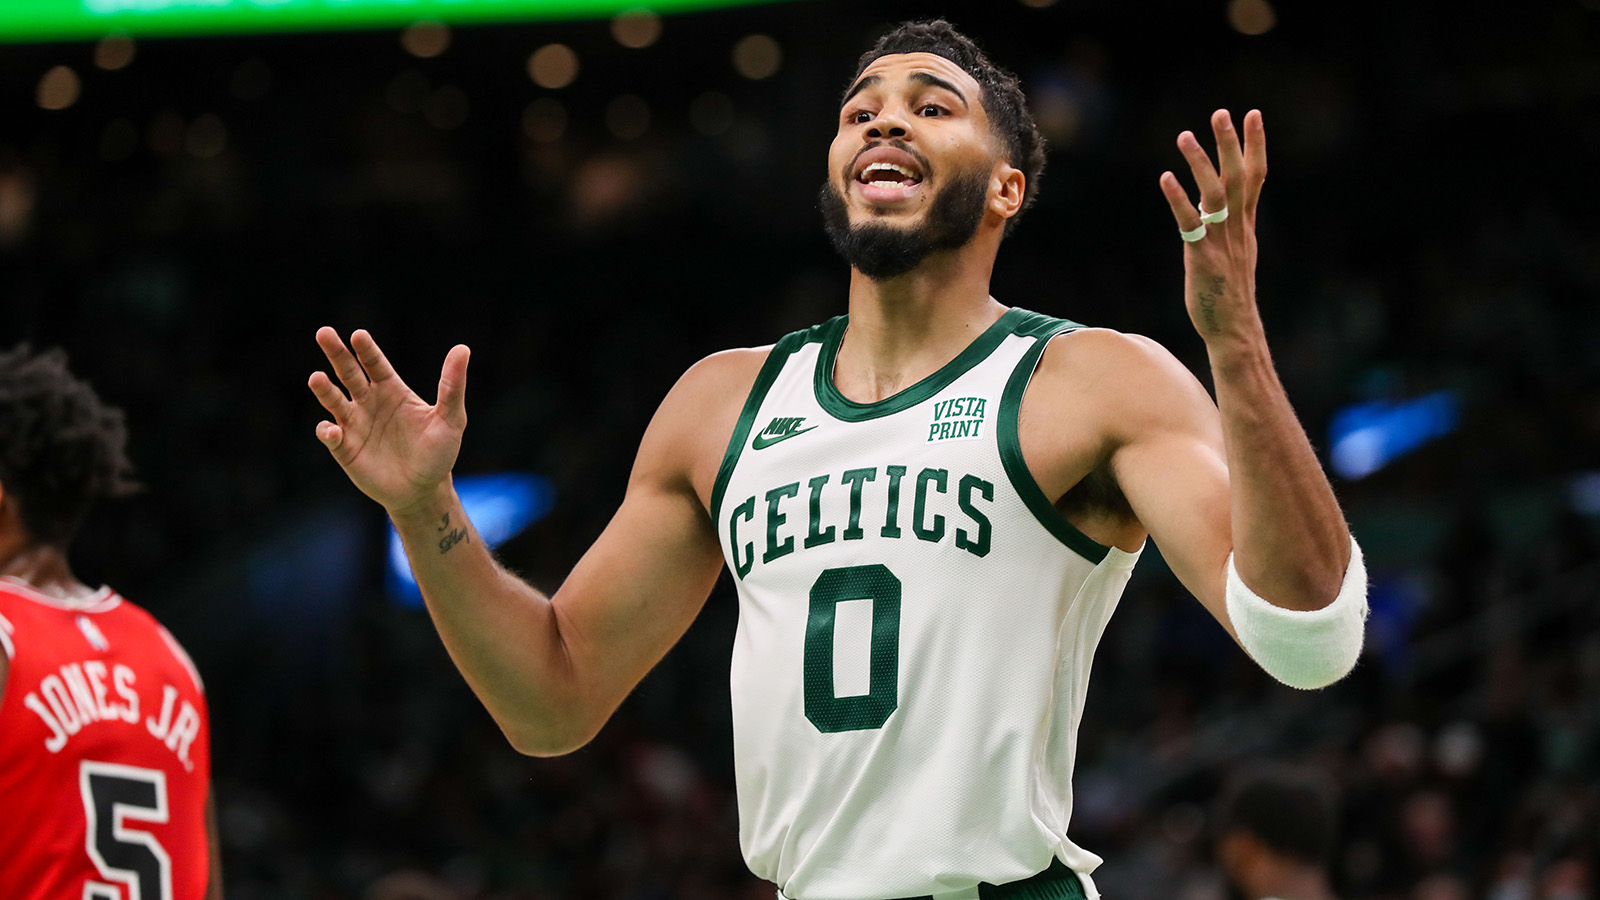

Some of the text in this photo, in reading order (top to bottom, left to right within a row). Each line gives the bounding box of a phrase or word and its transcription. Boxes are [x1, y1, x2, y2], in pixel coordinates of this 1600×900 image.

[763, 417, 807, 435] NIKE
[928, 419, 984, 441] PRINT
[934, 397, 987, 421] VISTA
[730, 465, 994, 581] CELTICS
[803, 564, 902, 733] 0
[24, 661, 140, 752] JONES
[80, 760, 173, 900] 5
